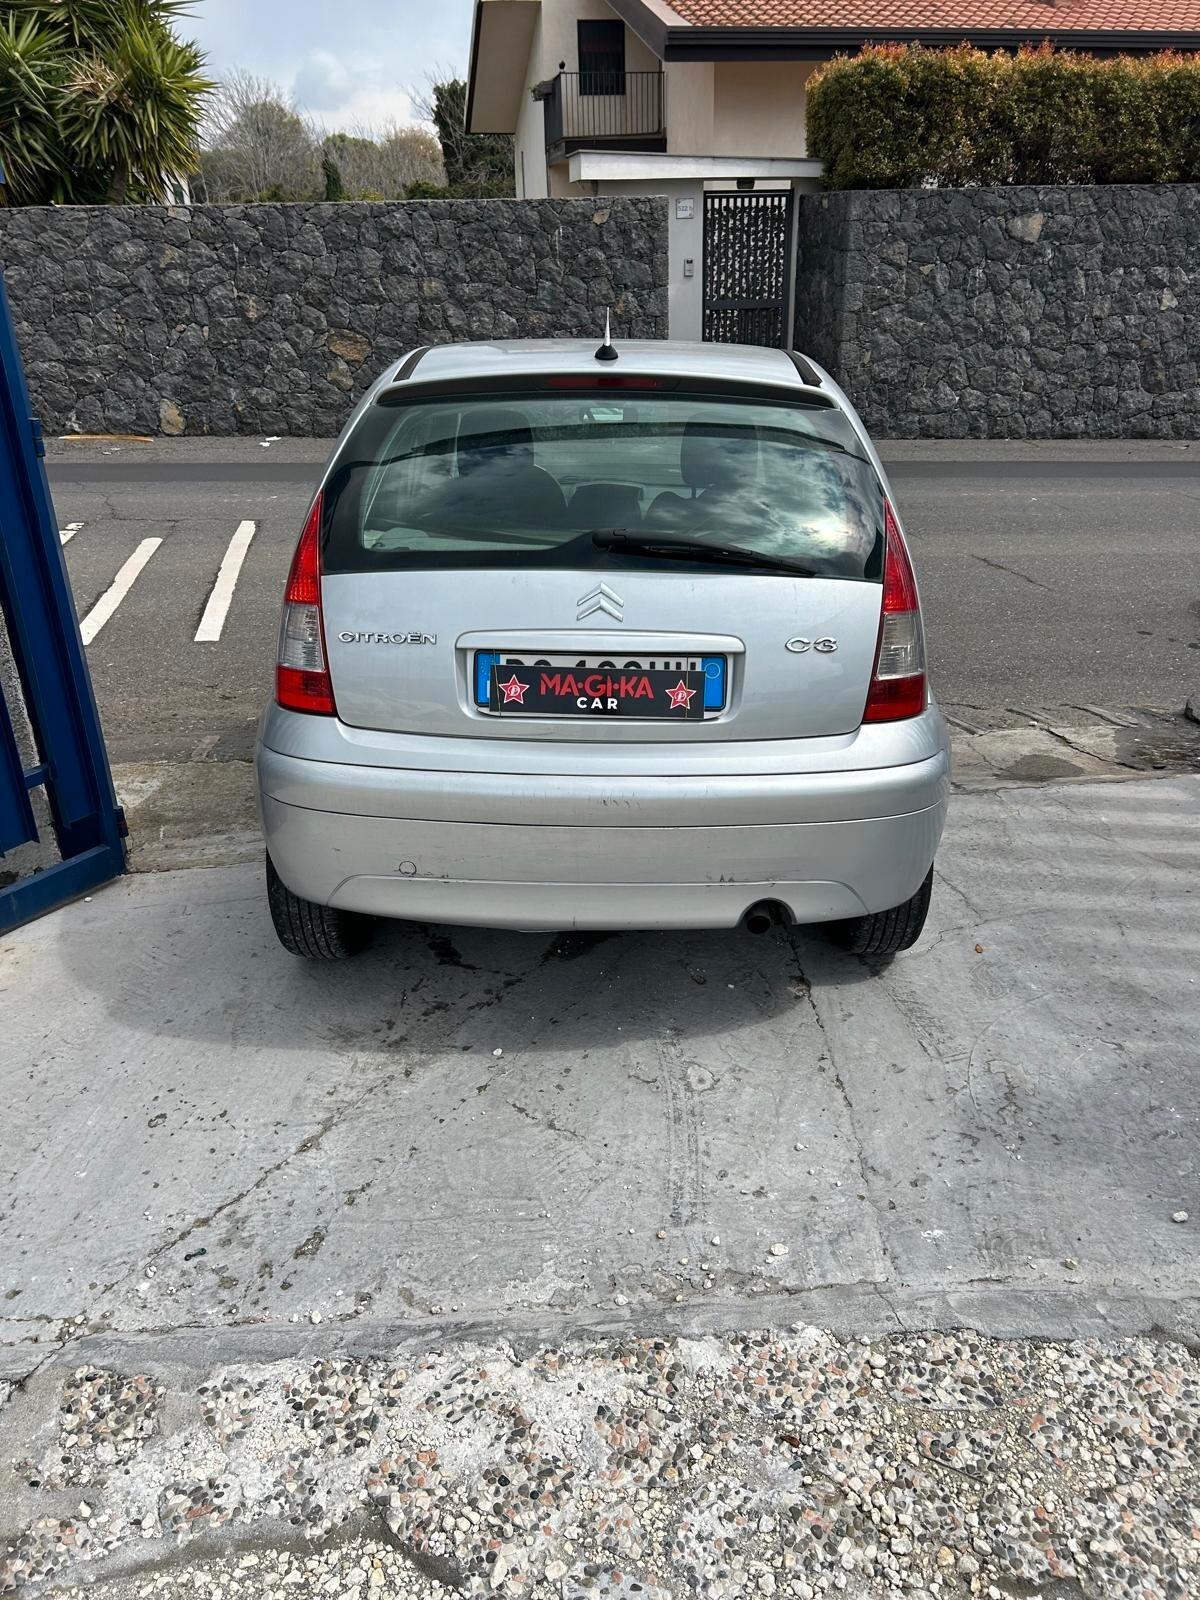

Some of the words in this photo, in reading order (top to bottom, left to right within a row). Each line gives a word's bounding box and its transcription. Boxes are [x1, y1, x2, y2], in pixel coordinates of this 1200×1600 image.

[338, 631, 437, 645] CITROËN
[785, 636, 838, 653] C3
[576, 696, 618, 710] CAR
